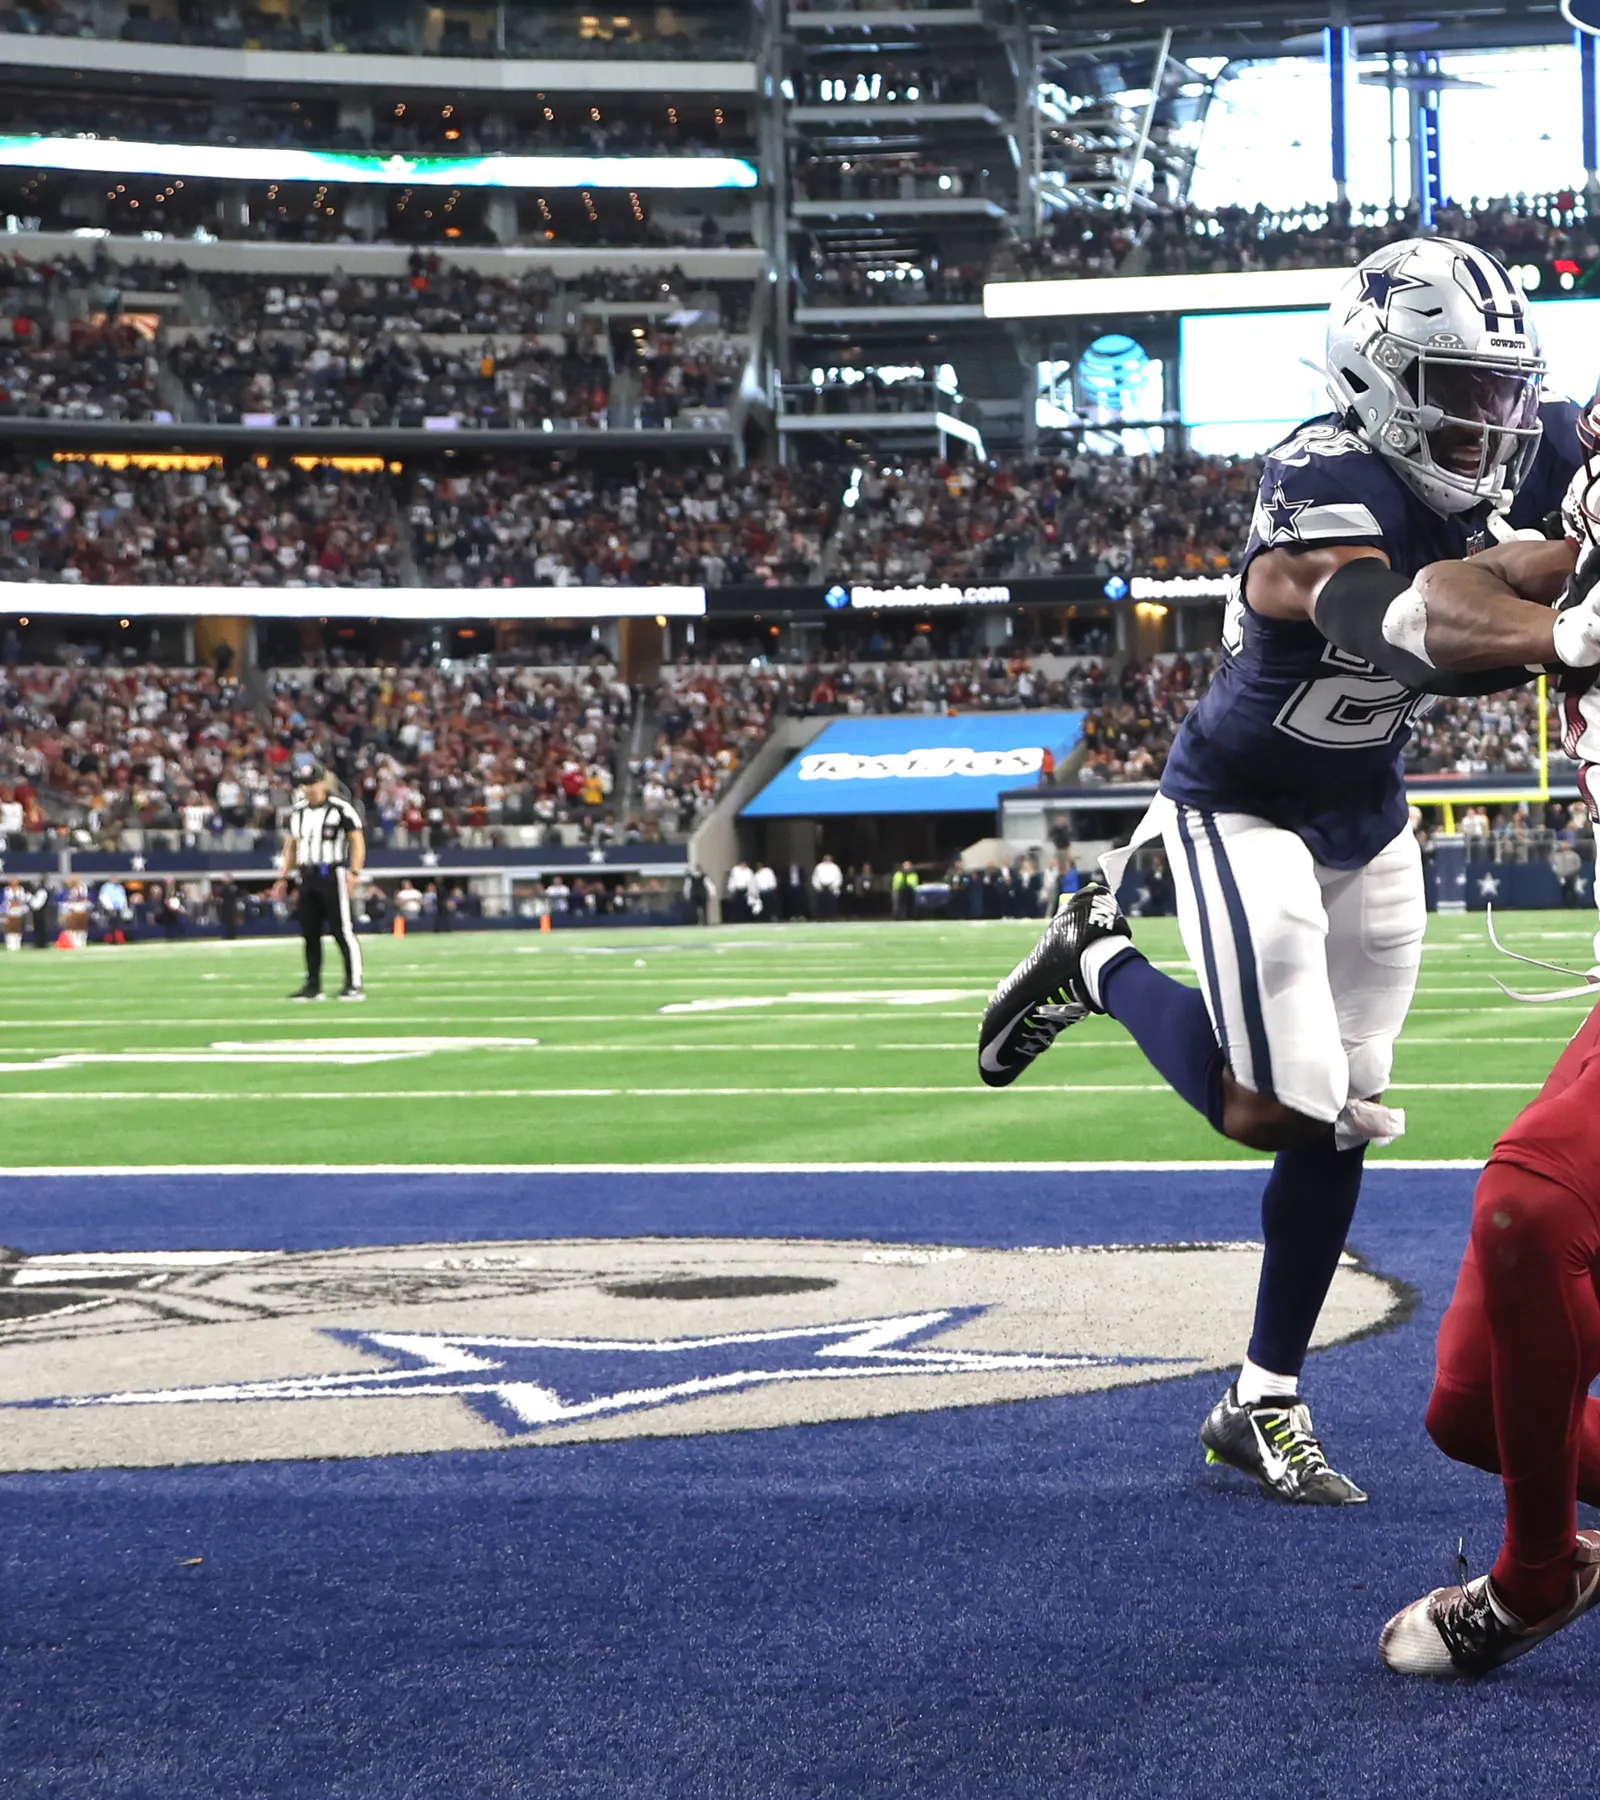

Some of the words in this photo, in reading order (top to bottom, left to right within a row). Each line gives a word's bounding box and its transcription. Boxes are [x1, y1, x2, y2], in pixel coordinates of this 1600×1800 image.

[1490, 338, 1526, 349] COWBOYS
[851, 583, 1011, 608] Blockchain.com
[1131, 574, 1234, 599] Blockchai
